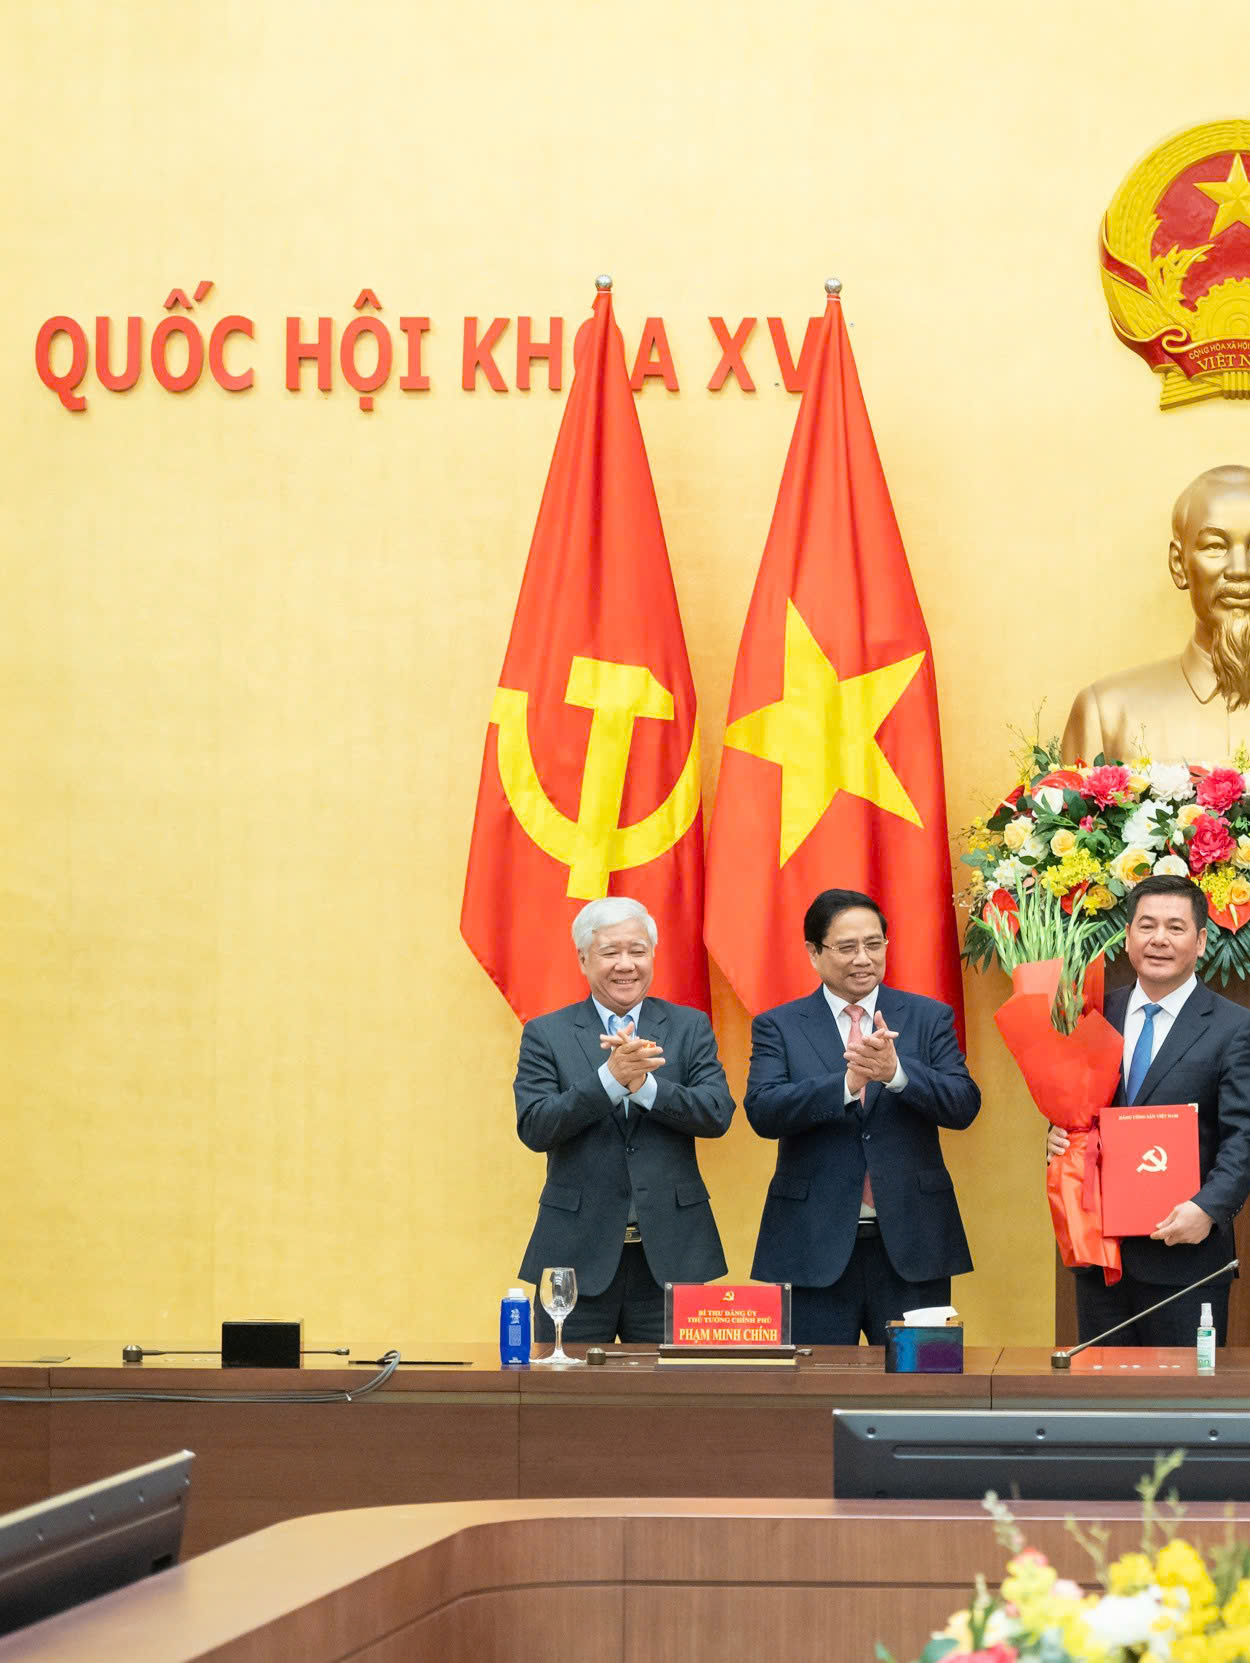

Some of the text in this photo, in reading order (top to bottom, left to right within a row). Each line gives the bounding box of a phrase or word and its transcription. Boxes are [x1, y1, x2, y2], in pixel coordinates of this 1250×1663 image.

[35, 281, 254, 412] QUỐC
[285, 288, 431, 413] HỘI
[706, 316, 827, 394] XV
[1197, 352, 1237, 371] VIỆT
[679, 1325, 778, 1344] PHẠM MINH CHÍNH
